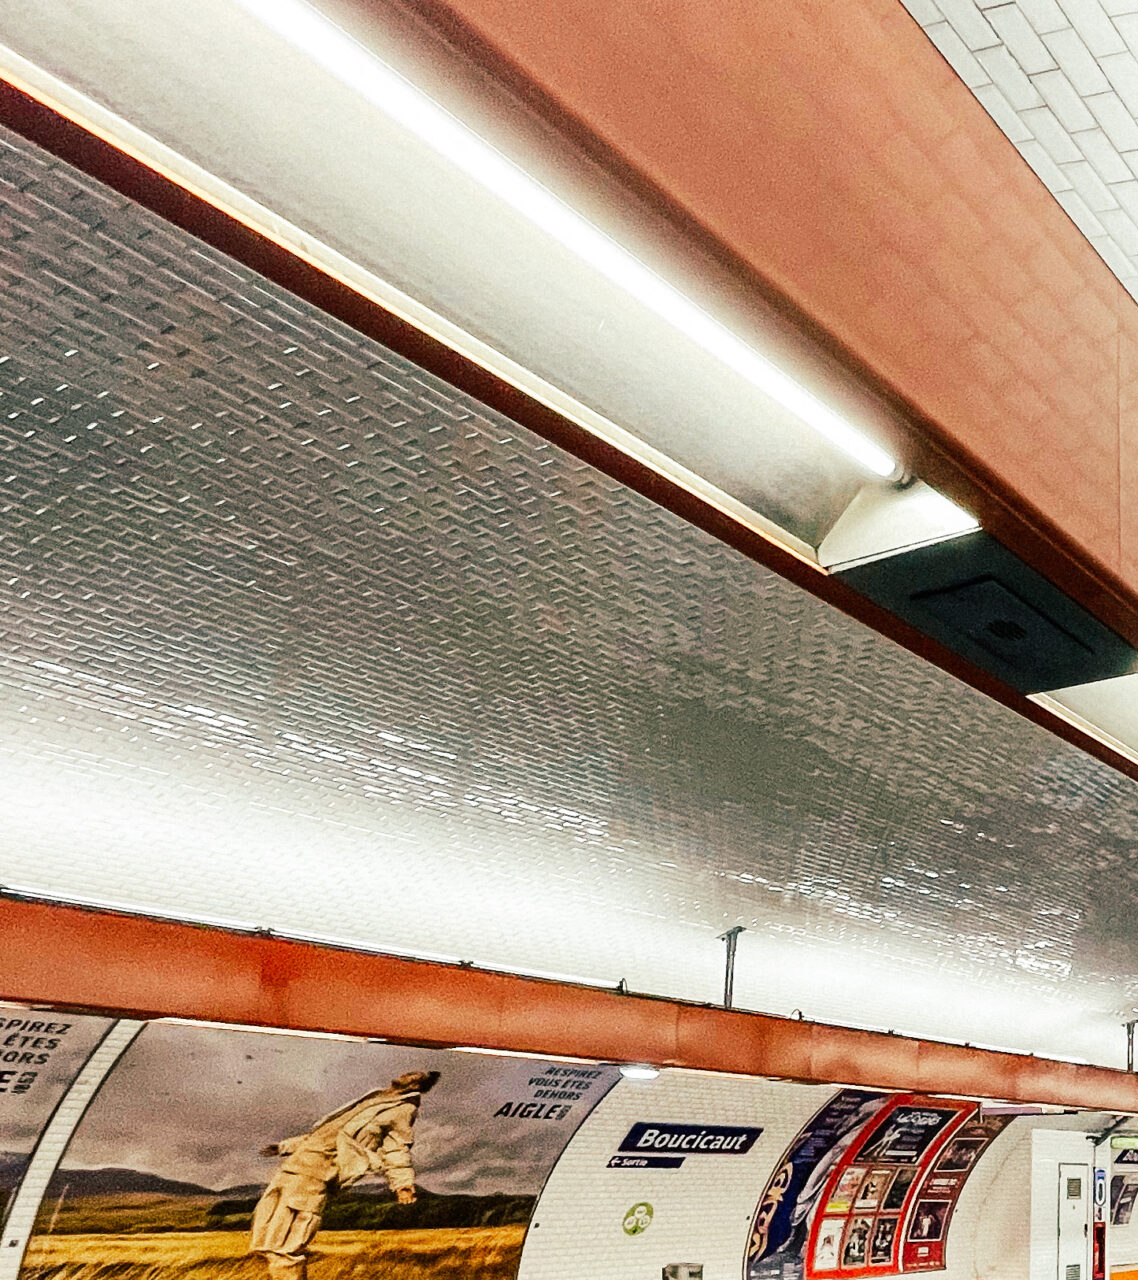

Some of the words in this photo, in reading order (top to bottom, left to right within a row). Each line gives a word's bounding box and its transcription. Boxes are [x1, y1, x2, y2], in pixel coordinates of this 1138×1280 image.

[544, 1067, 603, 1079] RESPIREZ
[528, 1077, 561, 1088] VOUS
[534, 1089, 583, 1101] DEHORS
[493, 1101, 562, 1119] AIGLE
[636, 1129, 748, 1150] Boucicaut
